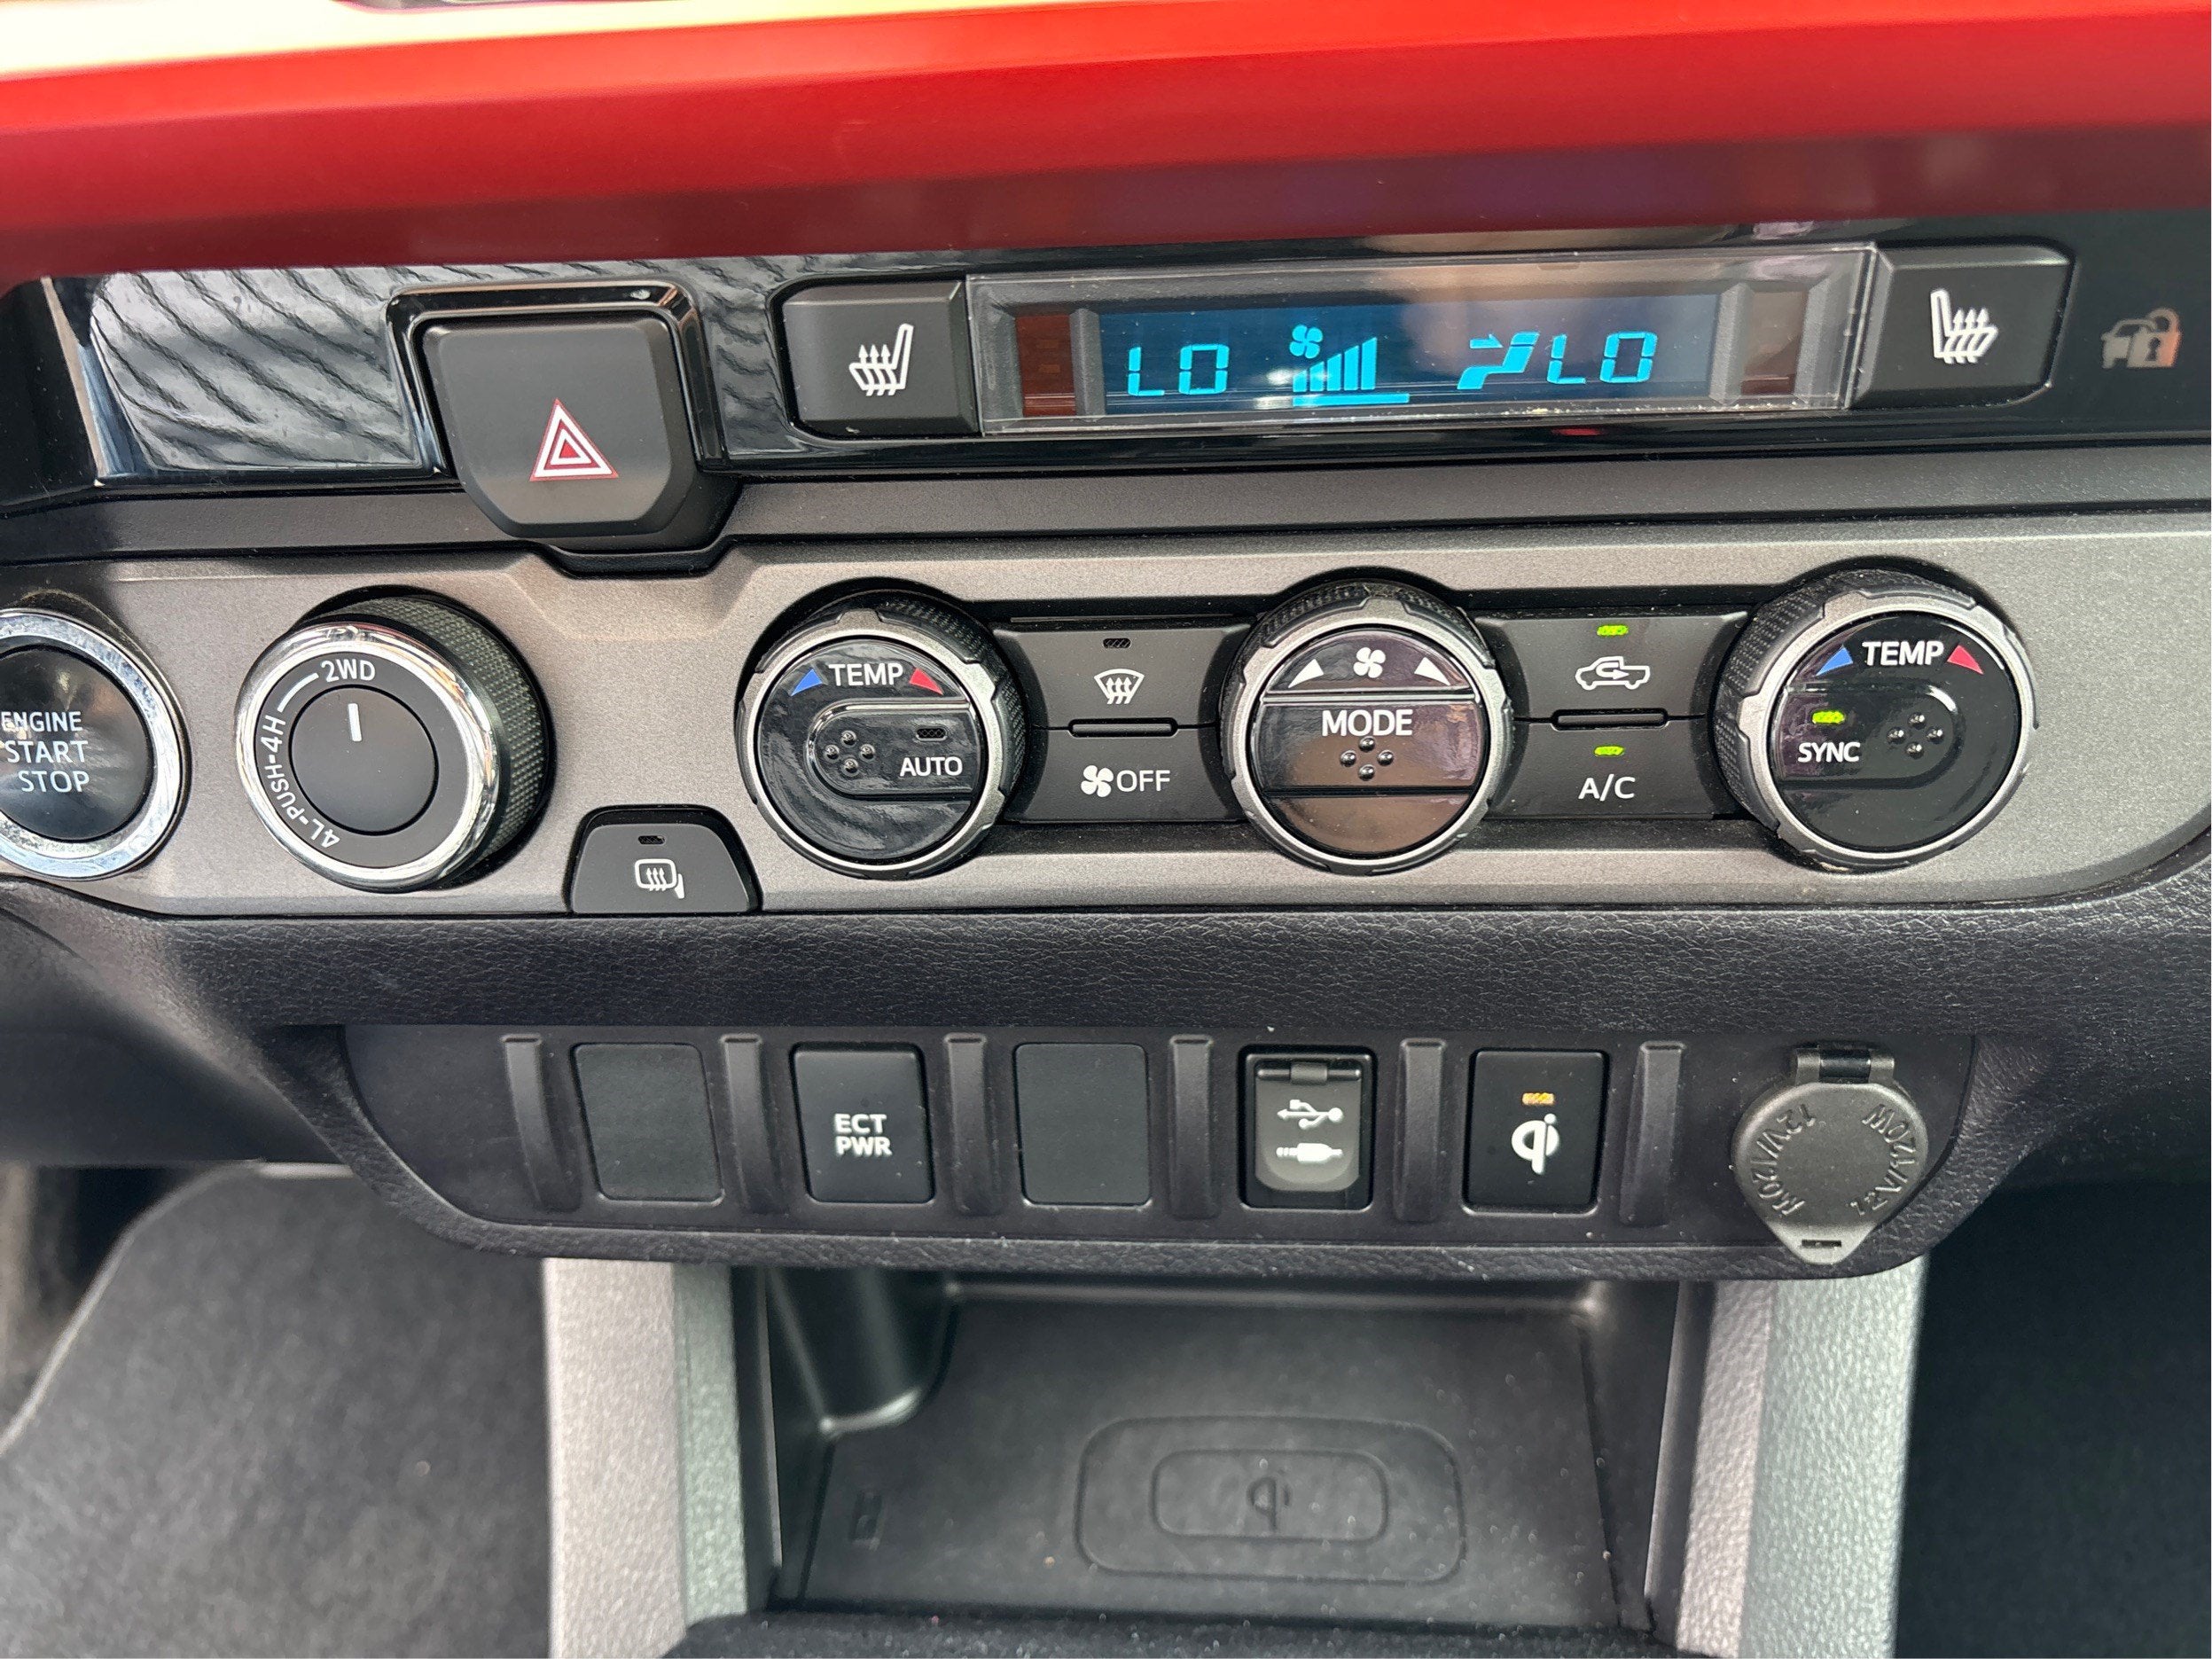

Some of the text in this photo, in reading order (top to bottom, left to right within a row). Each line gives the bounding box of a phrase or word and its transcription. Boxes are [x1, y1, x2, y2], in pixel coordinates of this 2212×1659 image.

[1862, 639, 1945, 667] TEMP
[320, 658, 376, 683] 2WD
[828, 661, 904, 688] TEMP
[0, 710, 84, 733] ENGINE
[1321, 708, 1413, 737] MODE
[4, 740, 90, 764] START
[1797, 741, 1861, 763] SYNC
[899, 755, 964, 778] AUTO
[17, 769, 90, 794] STOP
[1115, 769, 1171, 793] OFF
[1577, 773, 1637, 802] A/C
[834, 1113, 888, 1135] ECT
[835, 1135, 893, 1157] PWR
